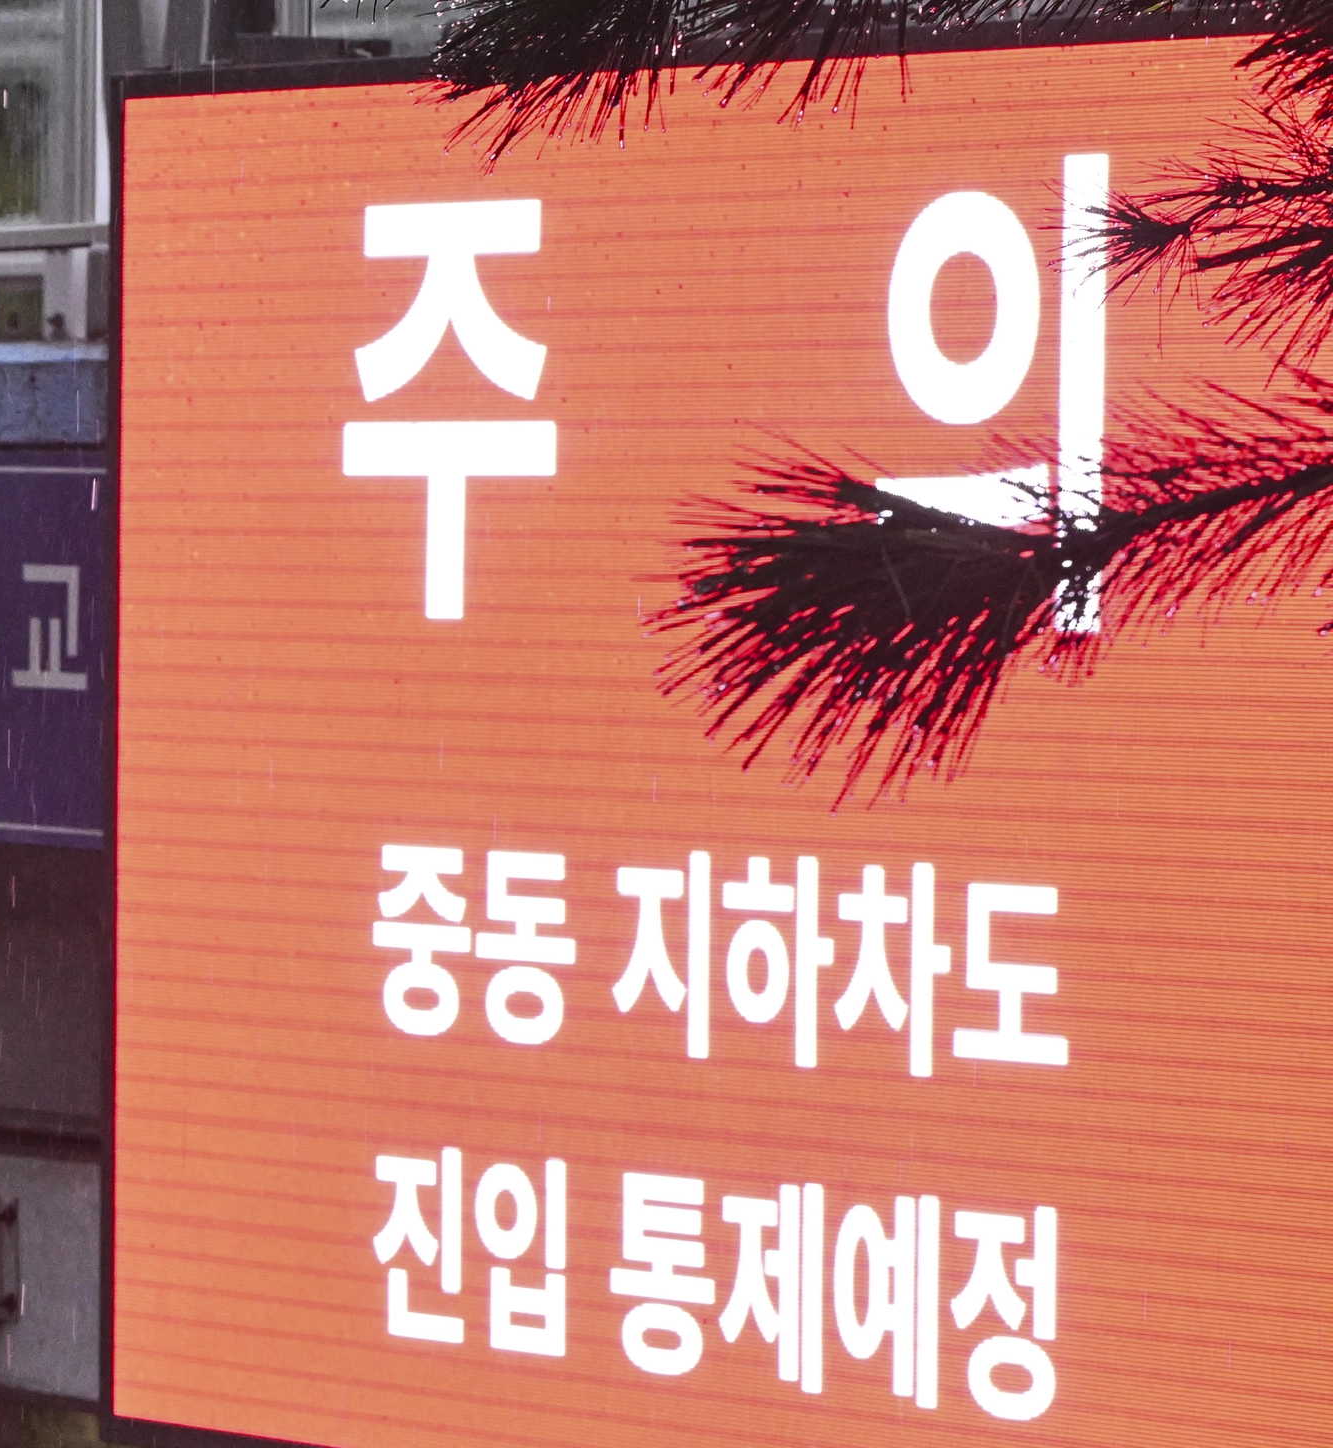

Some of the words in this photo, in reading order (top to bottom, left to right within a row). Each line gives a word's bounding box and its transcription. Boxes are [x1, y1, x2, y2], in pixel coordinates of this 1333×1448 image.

[341, 198, 558, 621] 주
[371, 843, 577, 1046] 중동
[611, 849, 1070, 1078] 지하차도
[372, 1145, 567, 1358] 진입
[609, 1171, 1058, 1422] 통제예정
